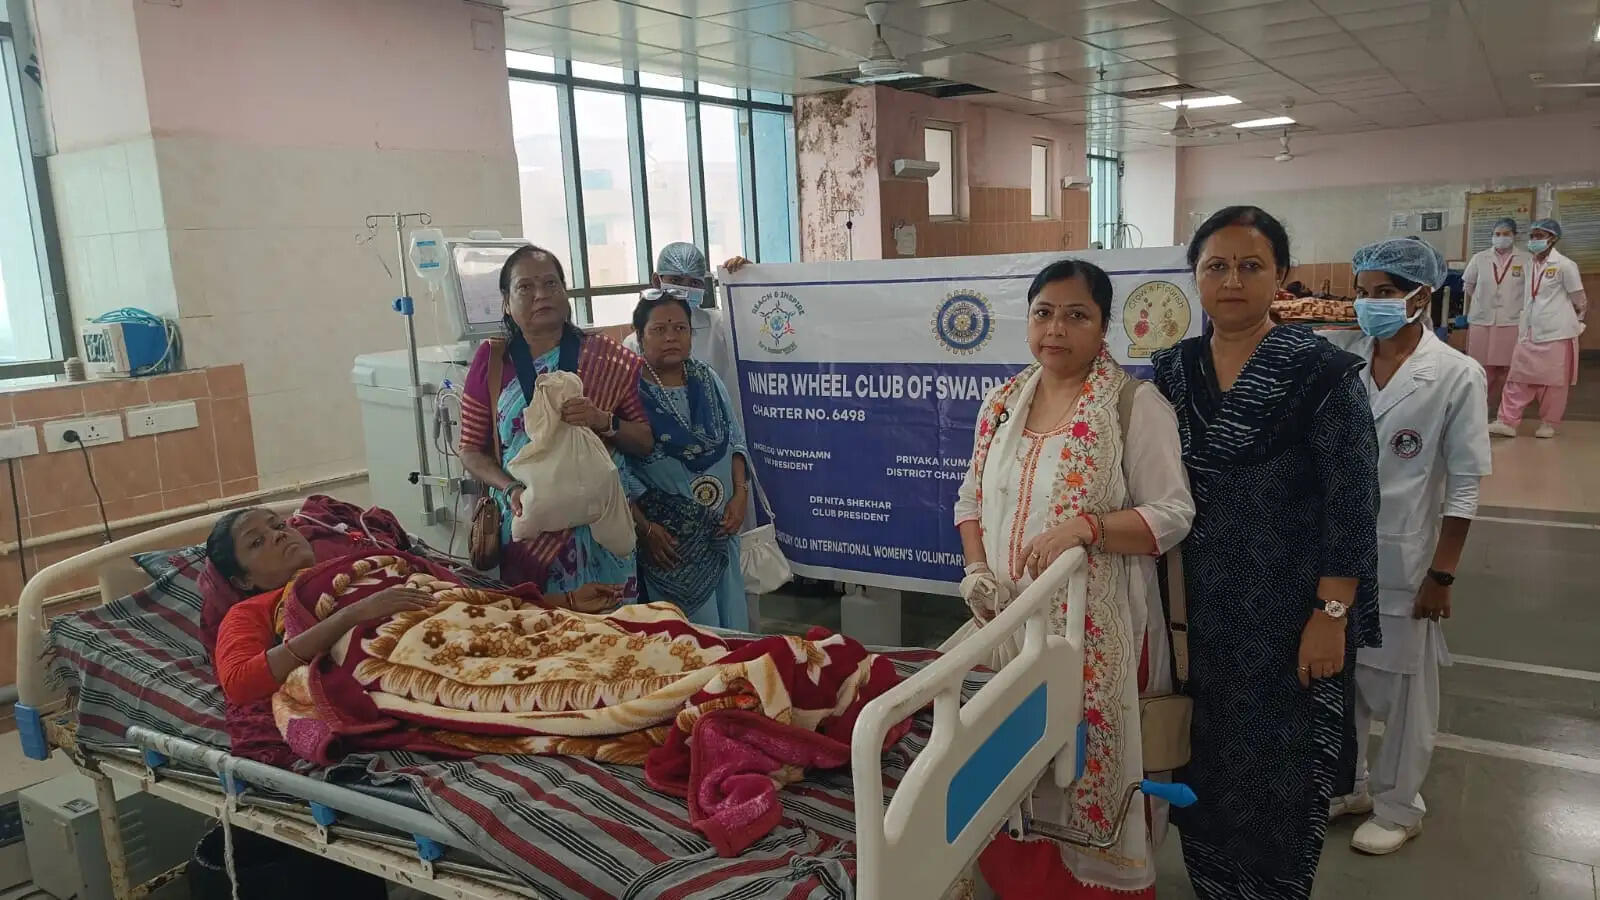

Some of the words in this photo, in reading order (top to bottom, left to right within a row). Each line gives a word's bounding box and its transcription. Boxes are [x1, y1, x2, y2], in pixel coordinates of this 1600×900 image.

[752, 293, 773, 314] REACH
[780, 291, 805, 316] INSPIRE
[748, 371, 788, 396] INNER
[791, 373, 853, 397] WHEEL
[855, 374, 904, 399] CLUB
[907, 375, 933, 399] OF
[752, 403, 803, 419] CHARTER
[805, 408, 830, 420] NO.
[832, 408, 866, 421] 6498
[776, 447, 831, 459] WYNDHAMN
[772, 459, 814, 471] PRESIDENT
[896, 455, 940, 466] PRIYAKA
[886, 467, 933, 478] DISTRICT
[809, 495, 823, 504] DR
[824, 496, 845, 506] NITA
[846, 498, 892, 510] SHEKHAR
[812, 508, 837, 518] CLUB
[837, 510, 891, 522] PRESIDENT
[794, 536, 808, 550] OLD
[809, 539, 872, 557] INTERNATIONAL
[873, 545, 913, 561] WOMEN'S
[915, 550, 967, 567] VOLUNTARY
